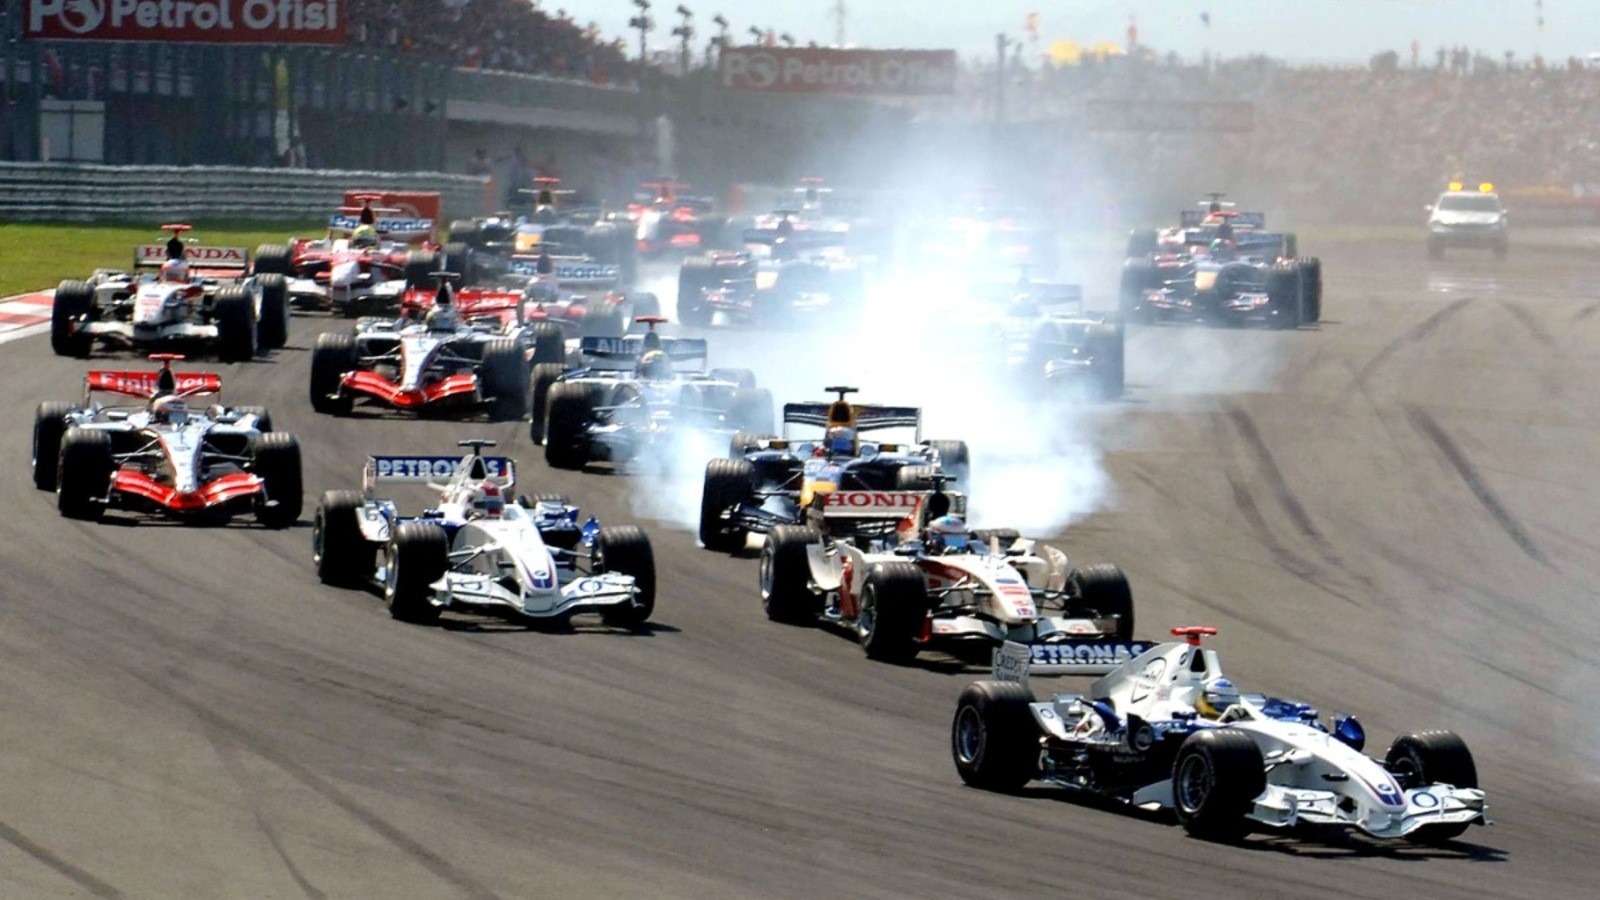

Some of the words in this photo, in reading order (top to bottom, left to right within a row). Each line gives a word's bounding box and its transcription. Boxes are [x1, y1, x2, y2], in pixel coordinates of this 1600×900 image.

[111, 0, 234, 29] Petrol
[242, 0, 337, 30] Ofisi
[783, 58, 874, 86] Petrol
[332, 215, 432, 231] Pasonic
[144, 247, 241, 259] HNDA
[511, 261, 616, 278] Pasonic
[597, 338, 641, 354] Allia
[378, 460, 500, 477] PETROS
[823, 492, 923, 507] HOND
[1029, 644, 1143, 664] ETRONAS
